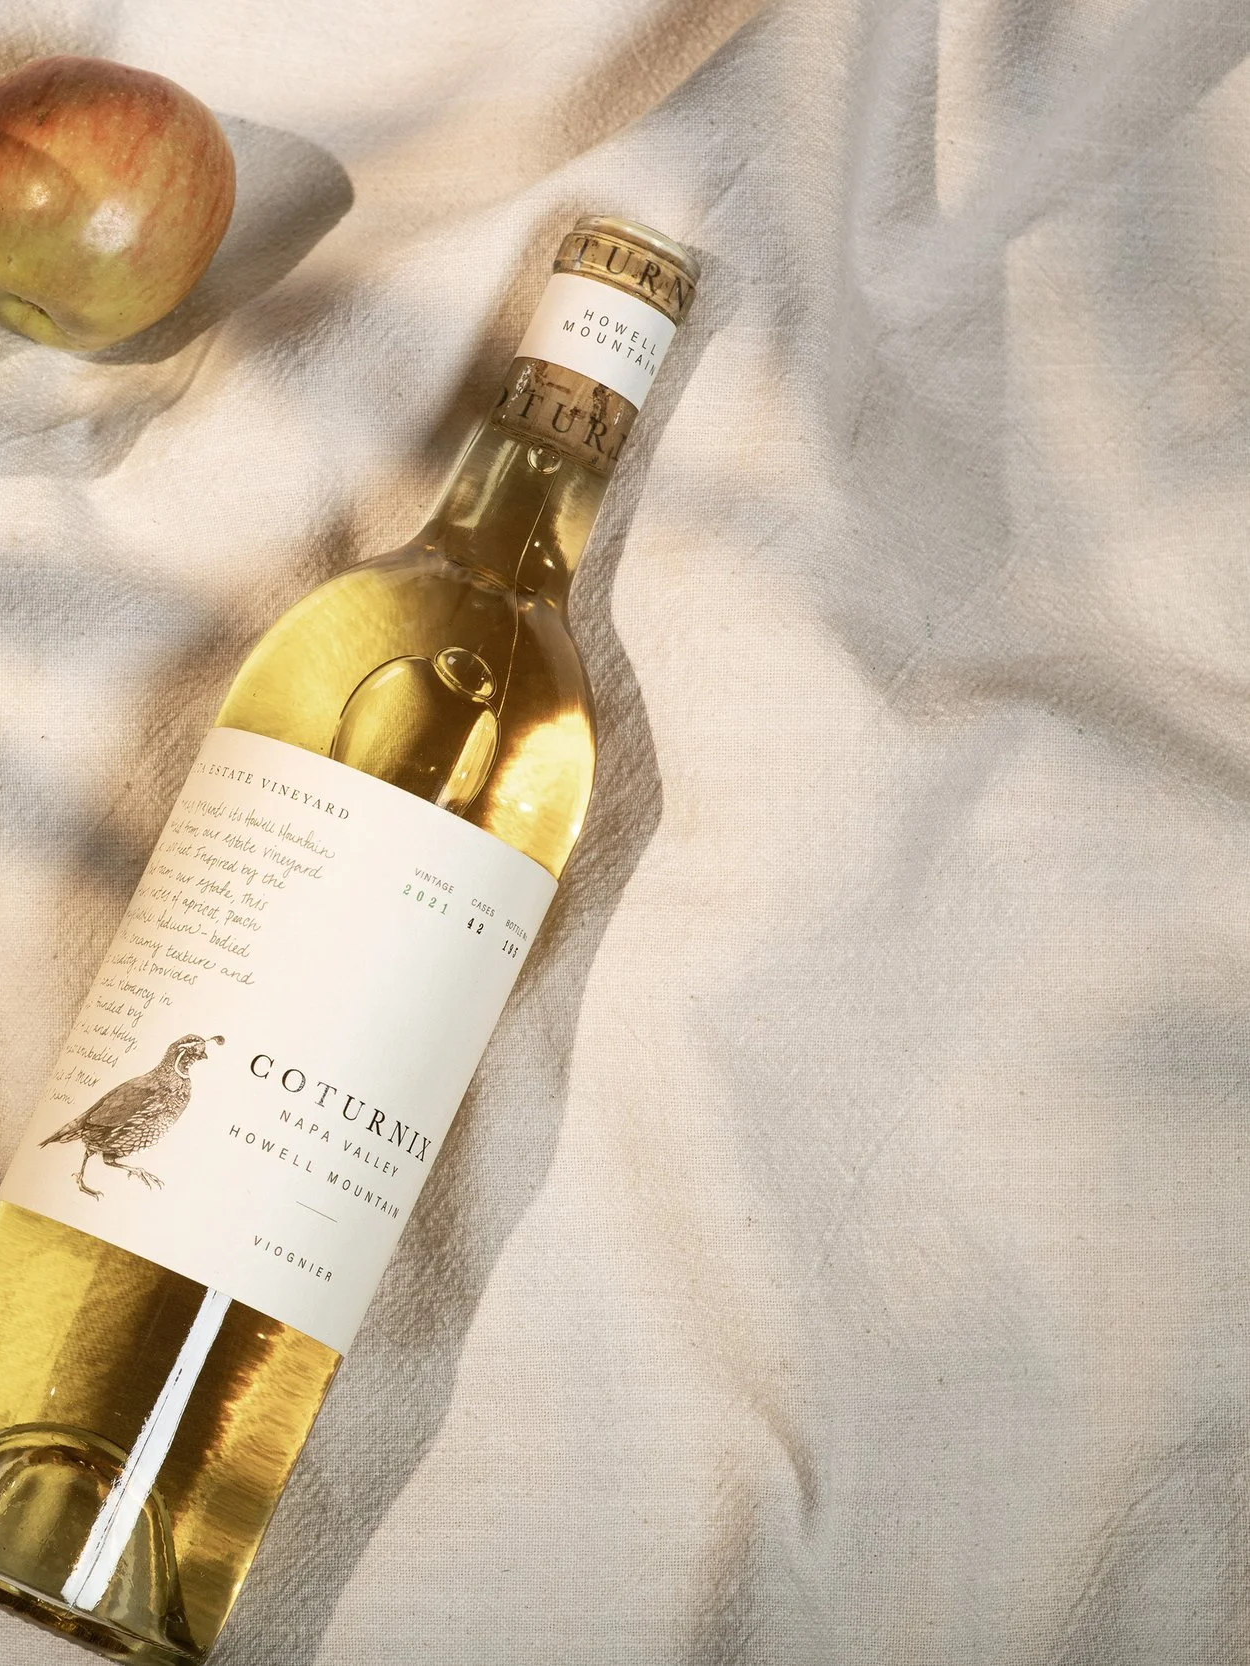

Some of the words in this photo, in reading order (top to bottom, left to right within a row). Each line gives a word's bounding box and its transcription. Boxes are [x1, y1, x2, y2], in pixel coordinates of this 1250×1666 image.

[563, 320, 656, 376] MOUNTAIN
[583, 309, 657, 355] HOWELL
[209, 764, 254, 784] ESTATE
[261, 778, 350, 820] VINEYARD
[202, 829, 221, 840] our
[222, 832, 257, 854] estate
[263, 845, 323, 879] vineyard
[229, 807, 243, 821] its
[245, 809, 275, 834] Howell
[278, 823, 336, 859] Mountain
[175, 872, 195, 883] our
[241, 891, 269, 911] this
[194, 846, 239, 871] Inspired
[241, 864, 259, 881] by
[262, 871, 286, 889] the
[172, 890, 182, 909] of
[402, 884, 449, 915] 2021
[466, 917, 484, 935] 42
[414, 867, 455, 894] VINTAGE
[471, 898, 496, 917] CASES
[138, 960, 149, 972] it
[149, 962, 198, 985] provides
[166, 942, 216, 970] texture
[221, 967, 255, 985] and
[117, 975, 155, 1009] vibrancy
[159, 992, 174, 1006] in
[127, 1005, 143, 1028] by
[250, 1053, 432, 1163] COTURNIX
[279, 1109, 331, 1143] NAPA
[343, 1140, 399, 1178] VALLEY
[229, 1124, 313, 1173] HOWELL
[327, 1170, 400, 1219] MOUNTAIN
[254, 1235, 333, 1282] VIOGNIER
